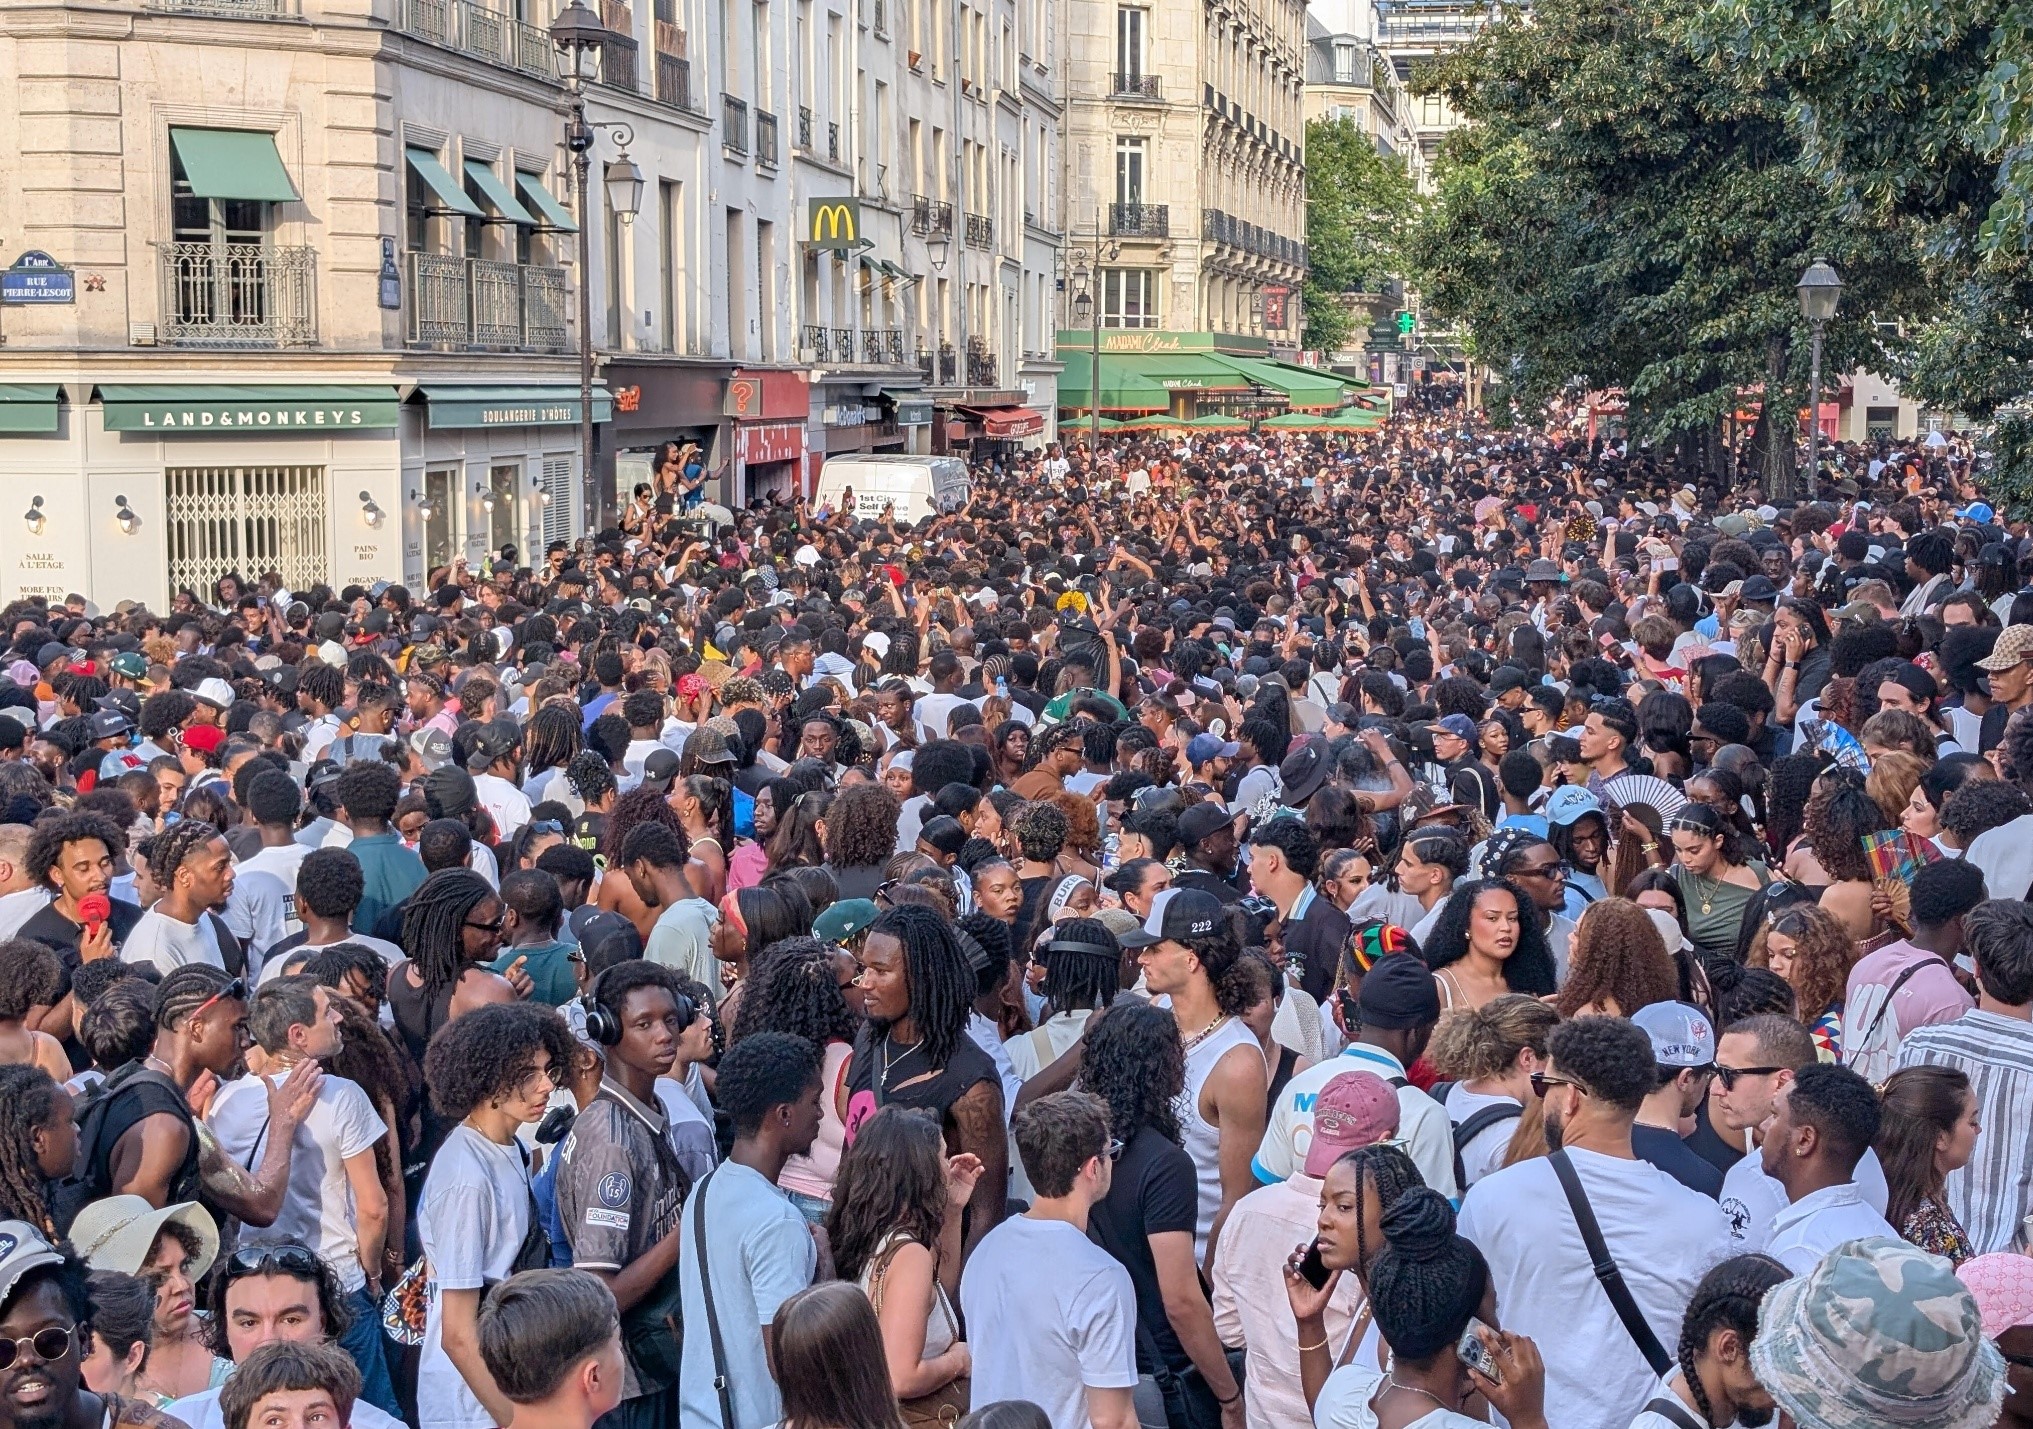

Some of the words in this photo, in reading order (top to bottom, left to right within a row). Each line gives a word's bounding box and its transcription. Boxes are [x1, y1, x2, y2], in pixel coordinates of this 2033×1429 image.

[26, 277, 48, 286] RUE
[3, 288, 71, 297] PIERRE-LESCOT
[144, 410, 362, 426] LAND&MONKEYS
[483, 409, 536, 423] BOULANGERIE
[542, 406, 572, 421] D'HÔTES
[859, 494, 875, 502] 1st
[859, 503, 879, 511] Self
[354, 545, 378, 553] PAINS
[26, 553, 54, 561] SALLE
[359, 553, 374, 561] BIO
[20, 586, 45, 594] MORE
[47, 586, 64, 594] FUN
[1191, 920, 1213, 933] 222
[1662, 1045, 1680, 1058] NEW
[1682, 1045, 1701, 1057] YORK
[609, 1188, 620, 1198] 15
[587, 1212, 629, 1225] FOUNDATION
